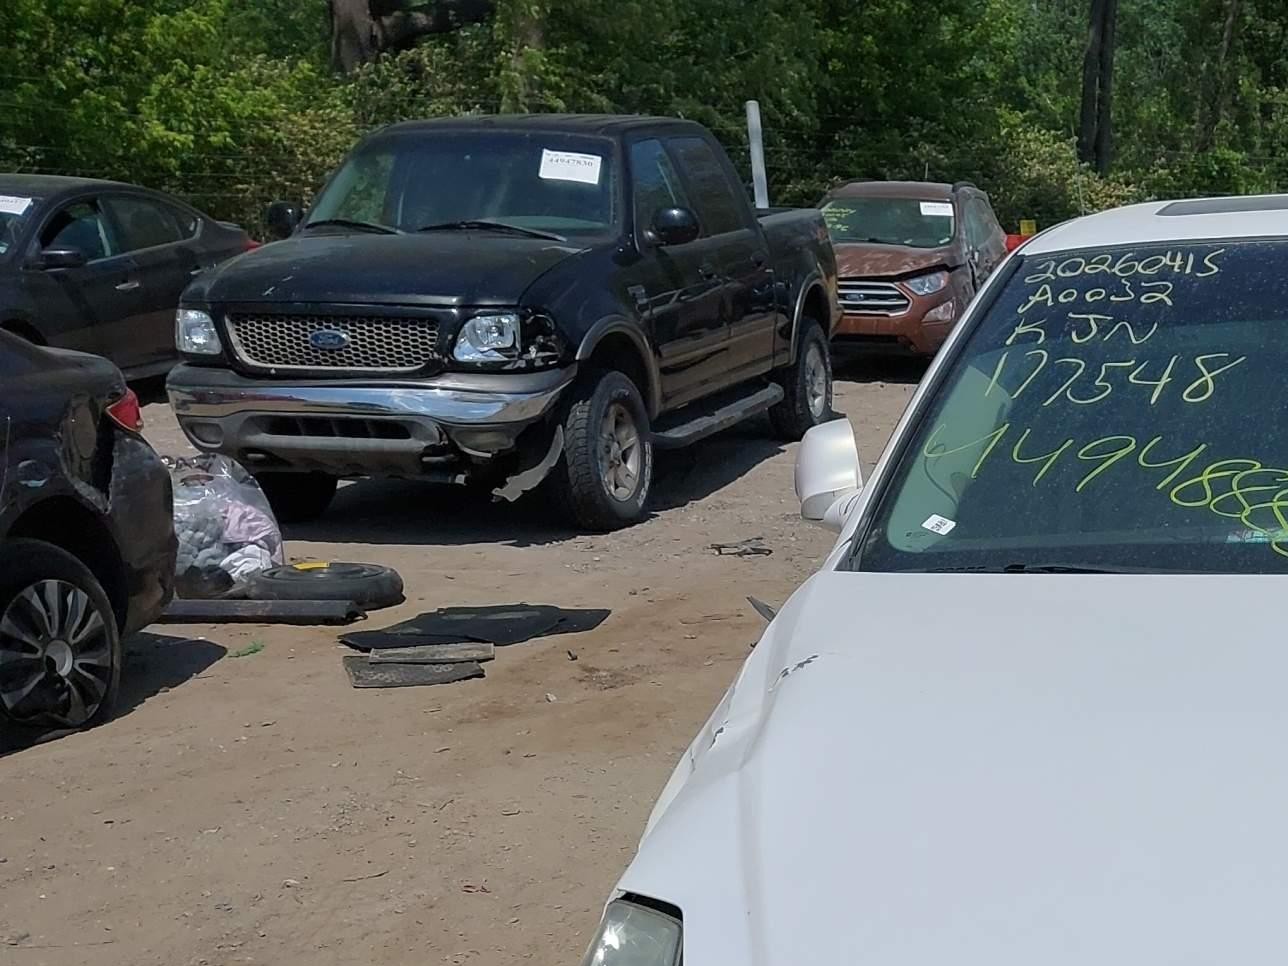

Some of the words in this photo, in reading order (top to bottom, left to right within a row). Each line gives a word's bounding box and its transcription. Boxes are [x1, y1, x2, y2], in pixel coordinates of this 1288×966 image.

[1024, 248, 1225, 283] 20260415
[1017, 278, 1173, 313] A0032
[984, 349, 1246, 407] 177548
